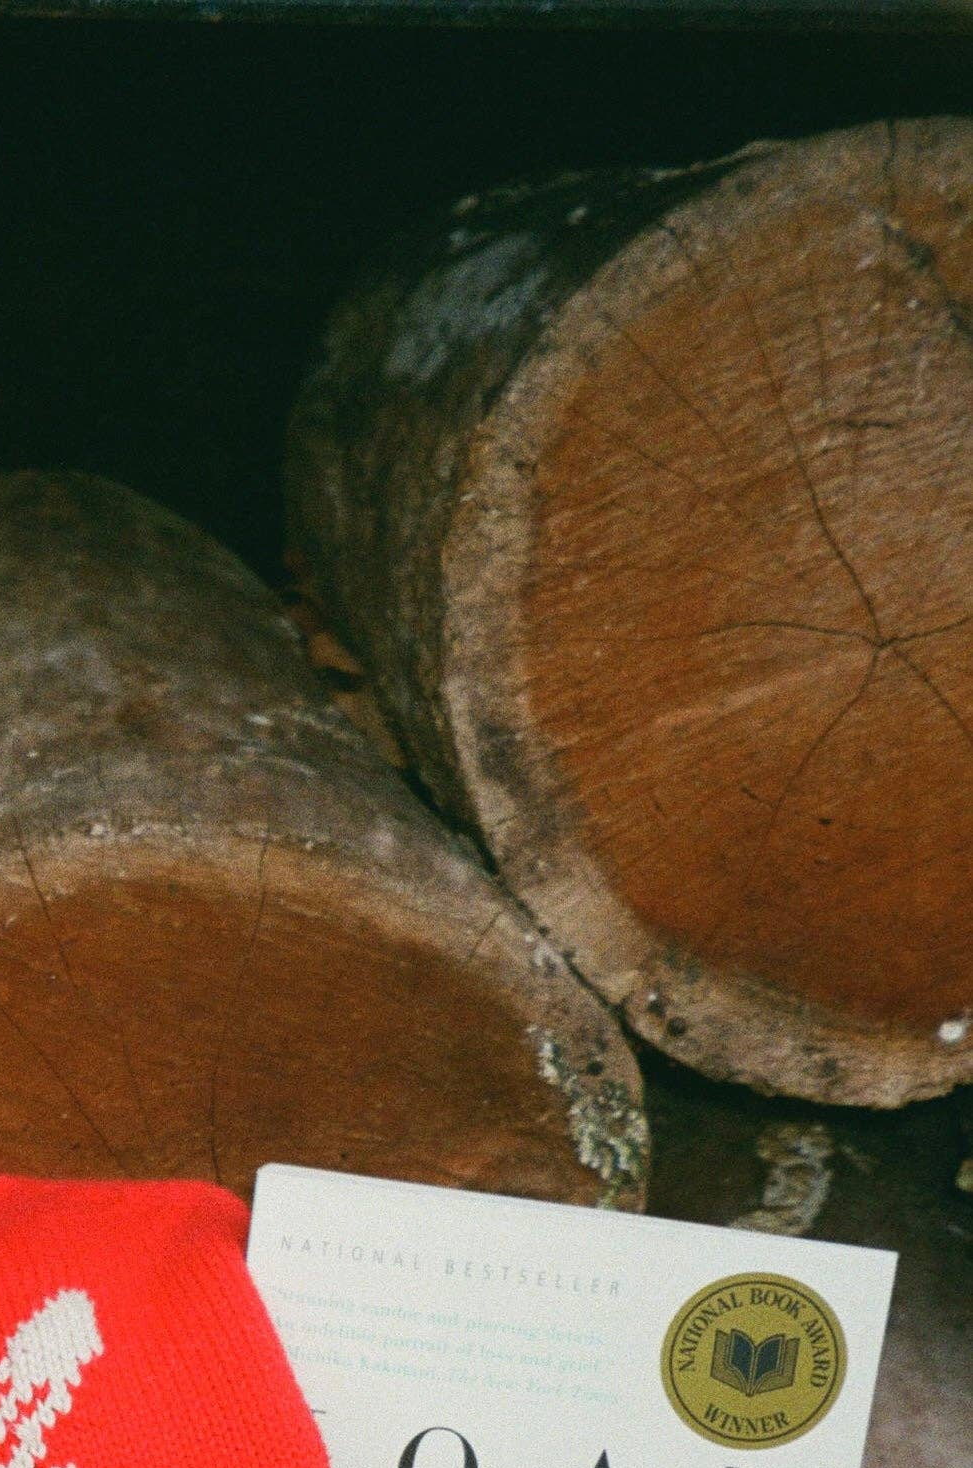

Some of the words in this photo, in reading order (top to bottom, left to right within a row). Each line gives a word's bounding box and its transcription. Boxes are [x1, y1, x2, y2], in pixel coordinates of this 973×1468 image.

[281, 1235, 422, 1270] NATIONAL
[444, 1259, 620, 1297] BESTSELLER
[677, 1291, 744, 1372] NATIONAL
[749, 1287, 803, 1319] BOOK
[801, 1318, 831, 1389] AWARD
[703, 1404, 792, 1435] WINNER
